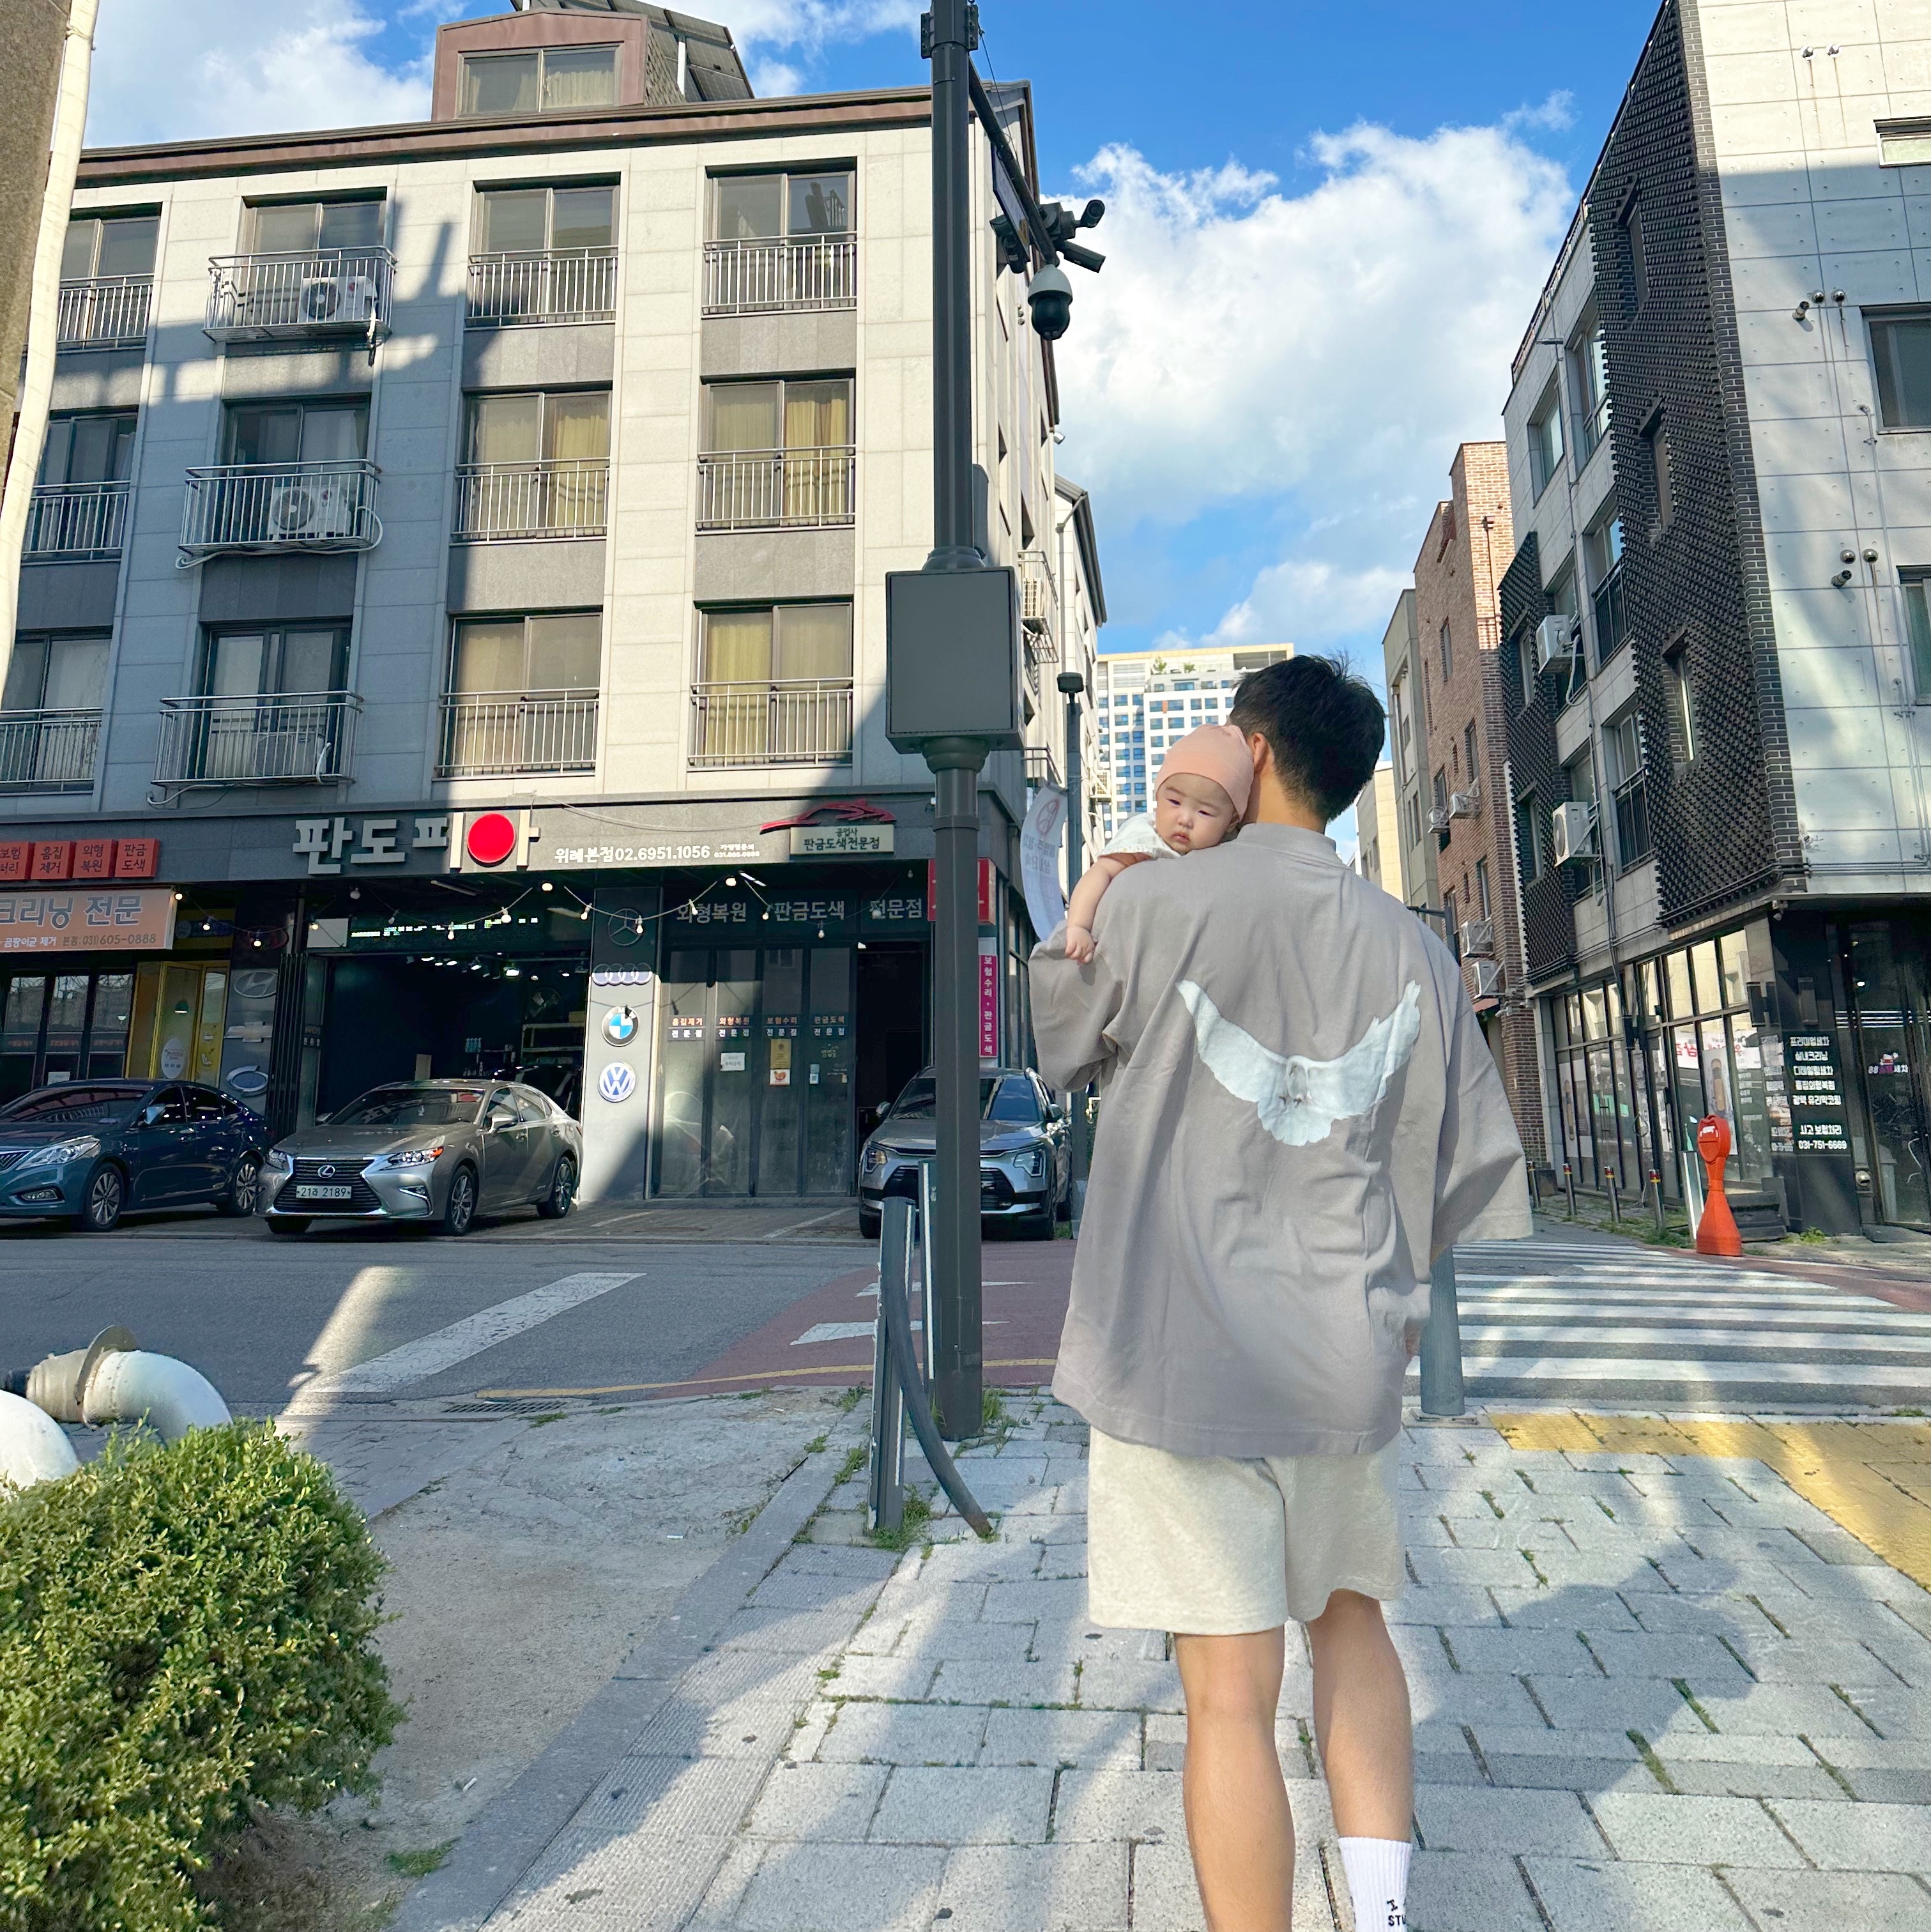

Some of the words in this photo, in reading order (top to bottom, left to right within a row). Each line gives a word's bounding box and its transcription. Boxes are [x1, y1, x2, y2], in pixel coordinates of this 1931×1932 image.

[836, 827, 858, 838] 공업사
[82, 844, 104, 858] 외형
[124, 843, 148, 857] 판금
[804, 837, 880, 852] 판금도색전문점
[40, 846, 63, 860] 흠집
[554, 847, 614, 864] 위례본점
[615, 845, 710, 861] 02.6951.1056
[39, 861, 61, 874] 제거
[80, 859, 103, 873] 복원
[122, 859, 146, 872] 도색
[84, 894, 142, 927] 전문
[676, 901, 747, 924] 외형복원
[773, 900, 846, 921] 판금도색
[869, 898, 922, 920] 전문점
[40, 936, 57, 947] 제거
[984, 956, 993, 997] 보험수리
[984, 1011, 993, 1054] 판금도색
[1800, 1124, 1814, 1135] 사고
[322, 1187, 346, 1197] 2189
